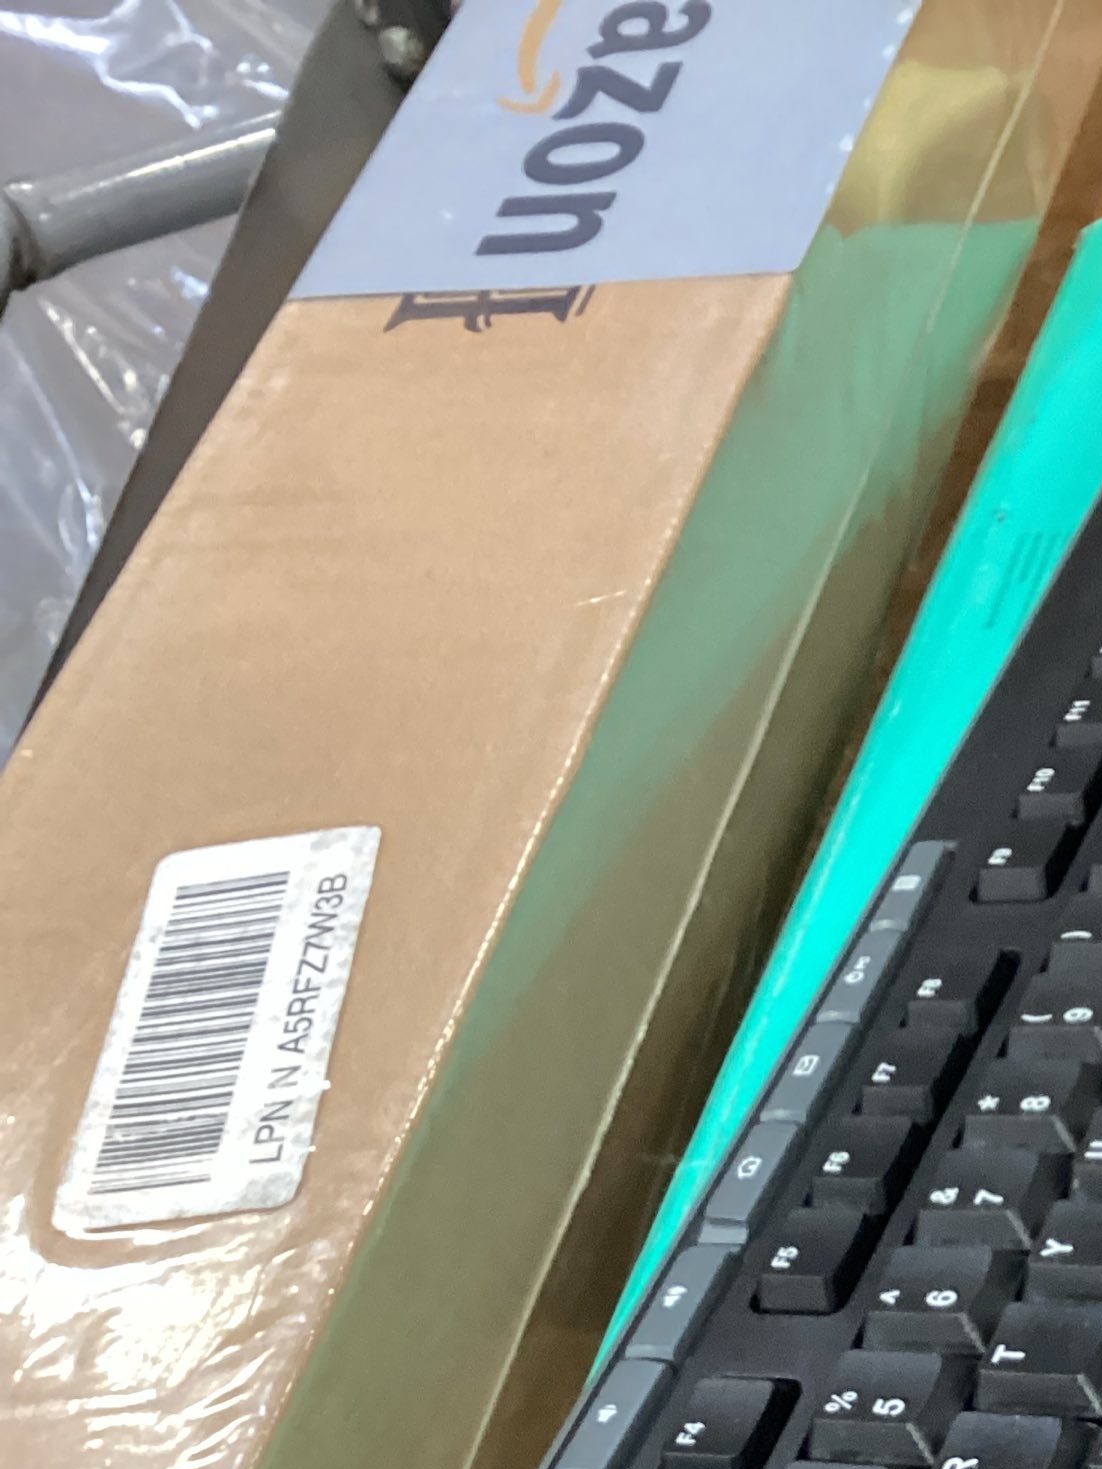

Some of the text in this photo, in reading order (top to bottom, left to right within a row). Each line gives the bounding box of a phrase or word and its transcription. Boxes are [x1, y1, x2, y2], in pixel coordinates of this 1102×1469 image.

[1064, 701, 1090, 721] F11
[1027, 768, 1054, 791] F10
[988, 848, 1011, 864] F9
[917, 979, 941, 997] F8
[249, 872, 348, 1164] LPN N A5RFZ7W3B
[1064, 1008, 1093, 1022] 9
[872, 1063, 895, 1082] F7
[1020, 1096, 1050, 1111] 8
[823, 1152, 849, 1172] F6
[930, 1188, 958, 1204] &
[974, 1190, 1003, 1205] 7
[1041, 1239, 1073, 1256] Y
[771, 1247, 798, 1268] F5
[880, 1290, 900, 1304] ^
[926, 1291, 957, 1307] 6
[991, 1345, 1025, 1363] T
[825, 1391, 857, 1412] %
[873, 1399, 905, 1416] 5
[676, 1422, 705, 1444] F4
